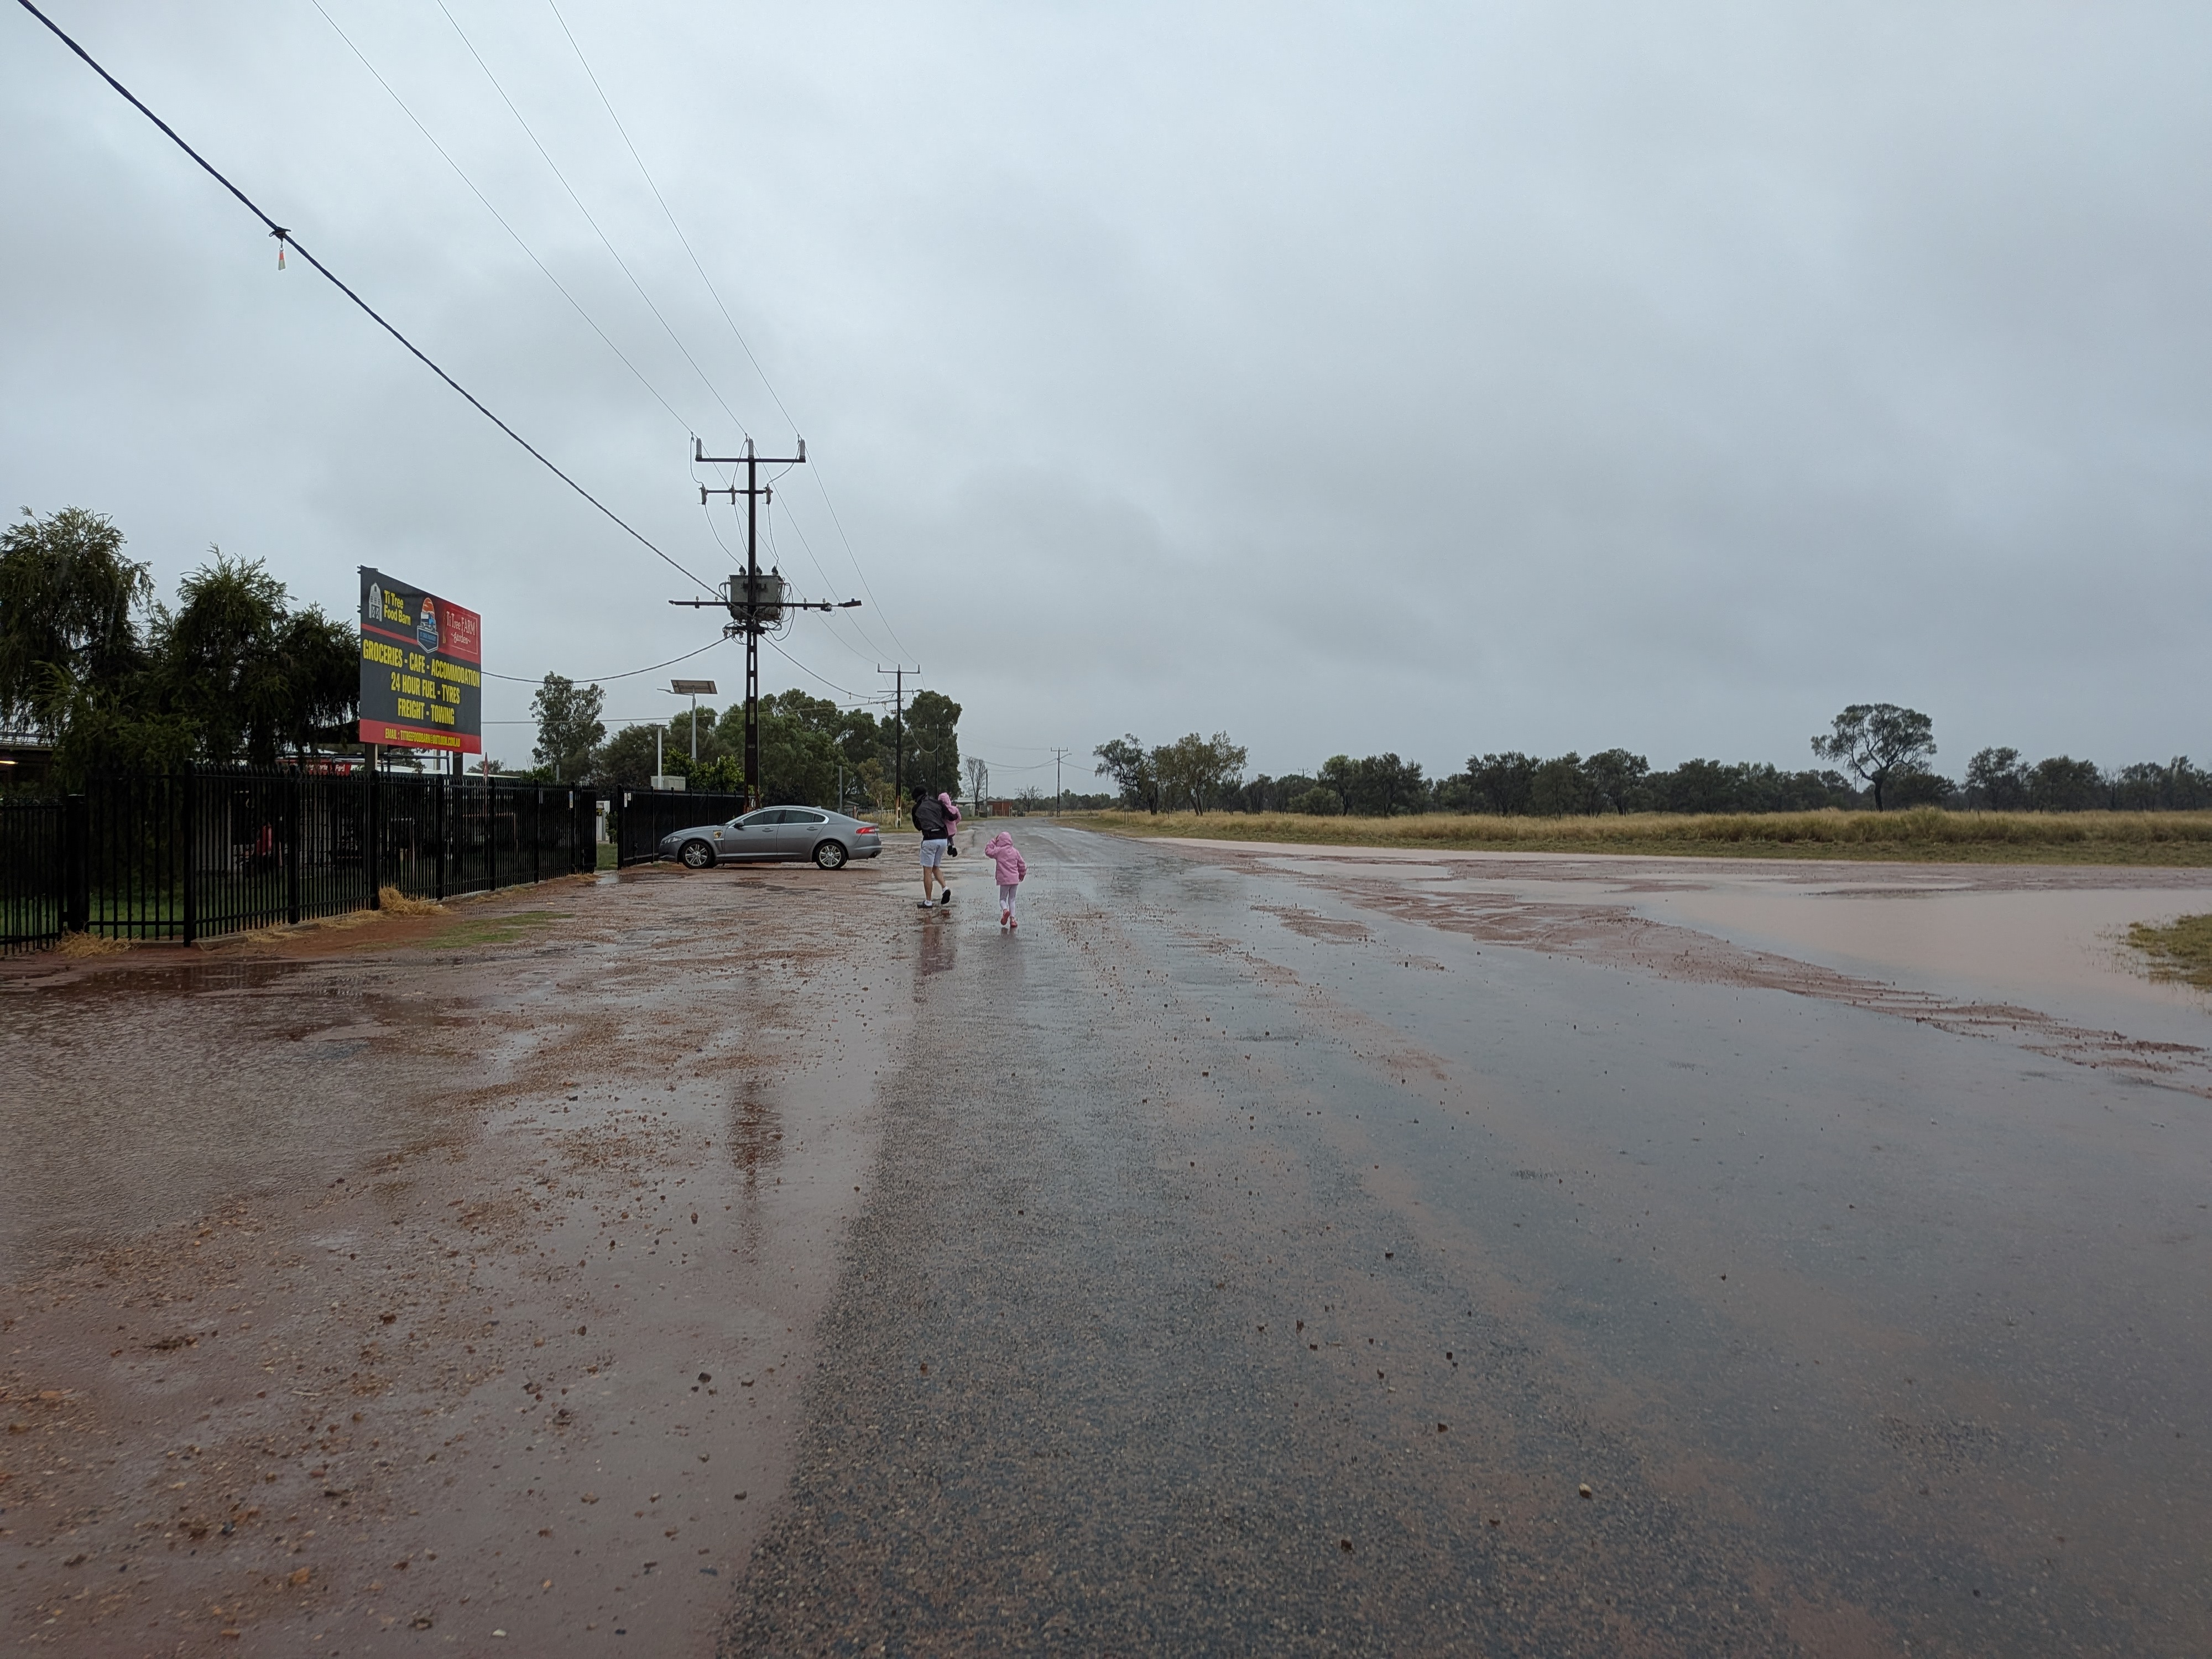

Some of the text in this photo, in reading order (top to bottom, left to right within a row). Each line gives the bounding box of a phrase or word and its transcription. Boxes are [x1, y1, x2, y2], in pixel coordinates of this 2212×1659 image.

[384, 589, 404, 609] Ti Tree
[384, 604, 411, 626] Food Barn
[446, 611, 475, 635] Ti Tree FARM
[363, 639, 403, 668] GROCERIES
[409, 652, 425, 674] CAFE
[431, 659, 480, 688] ACCOMMODATION
[391, 672, 400, 691] 24
[402, 674, 420, 696] HOUR
[422, 679, 436, 700] FUEL
[442, 684, 460, 705] TYRES
[398, 698, 425, 720] FREIGHT
[431, 704, 455, 725] TOWING
[385, 728, 397, 739] EMAIL
